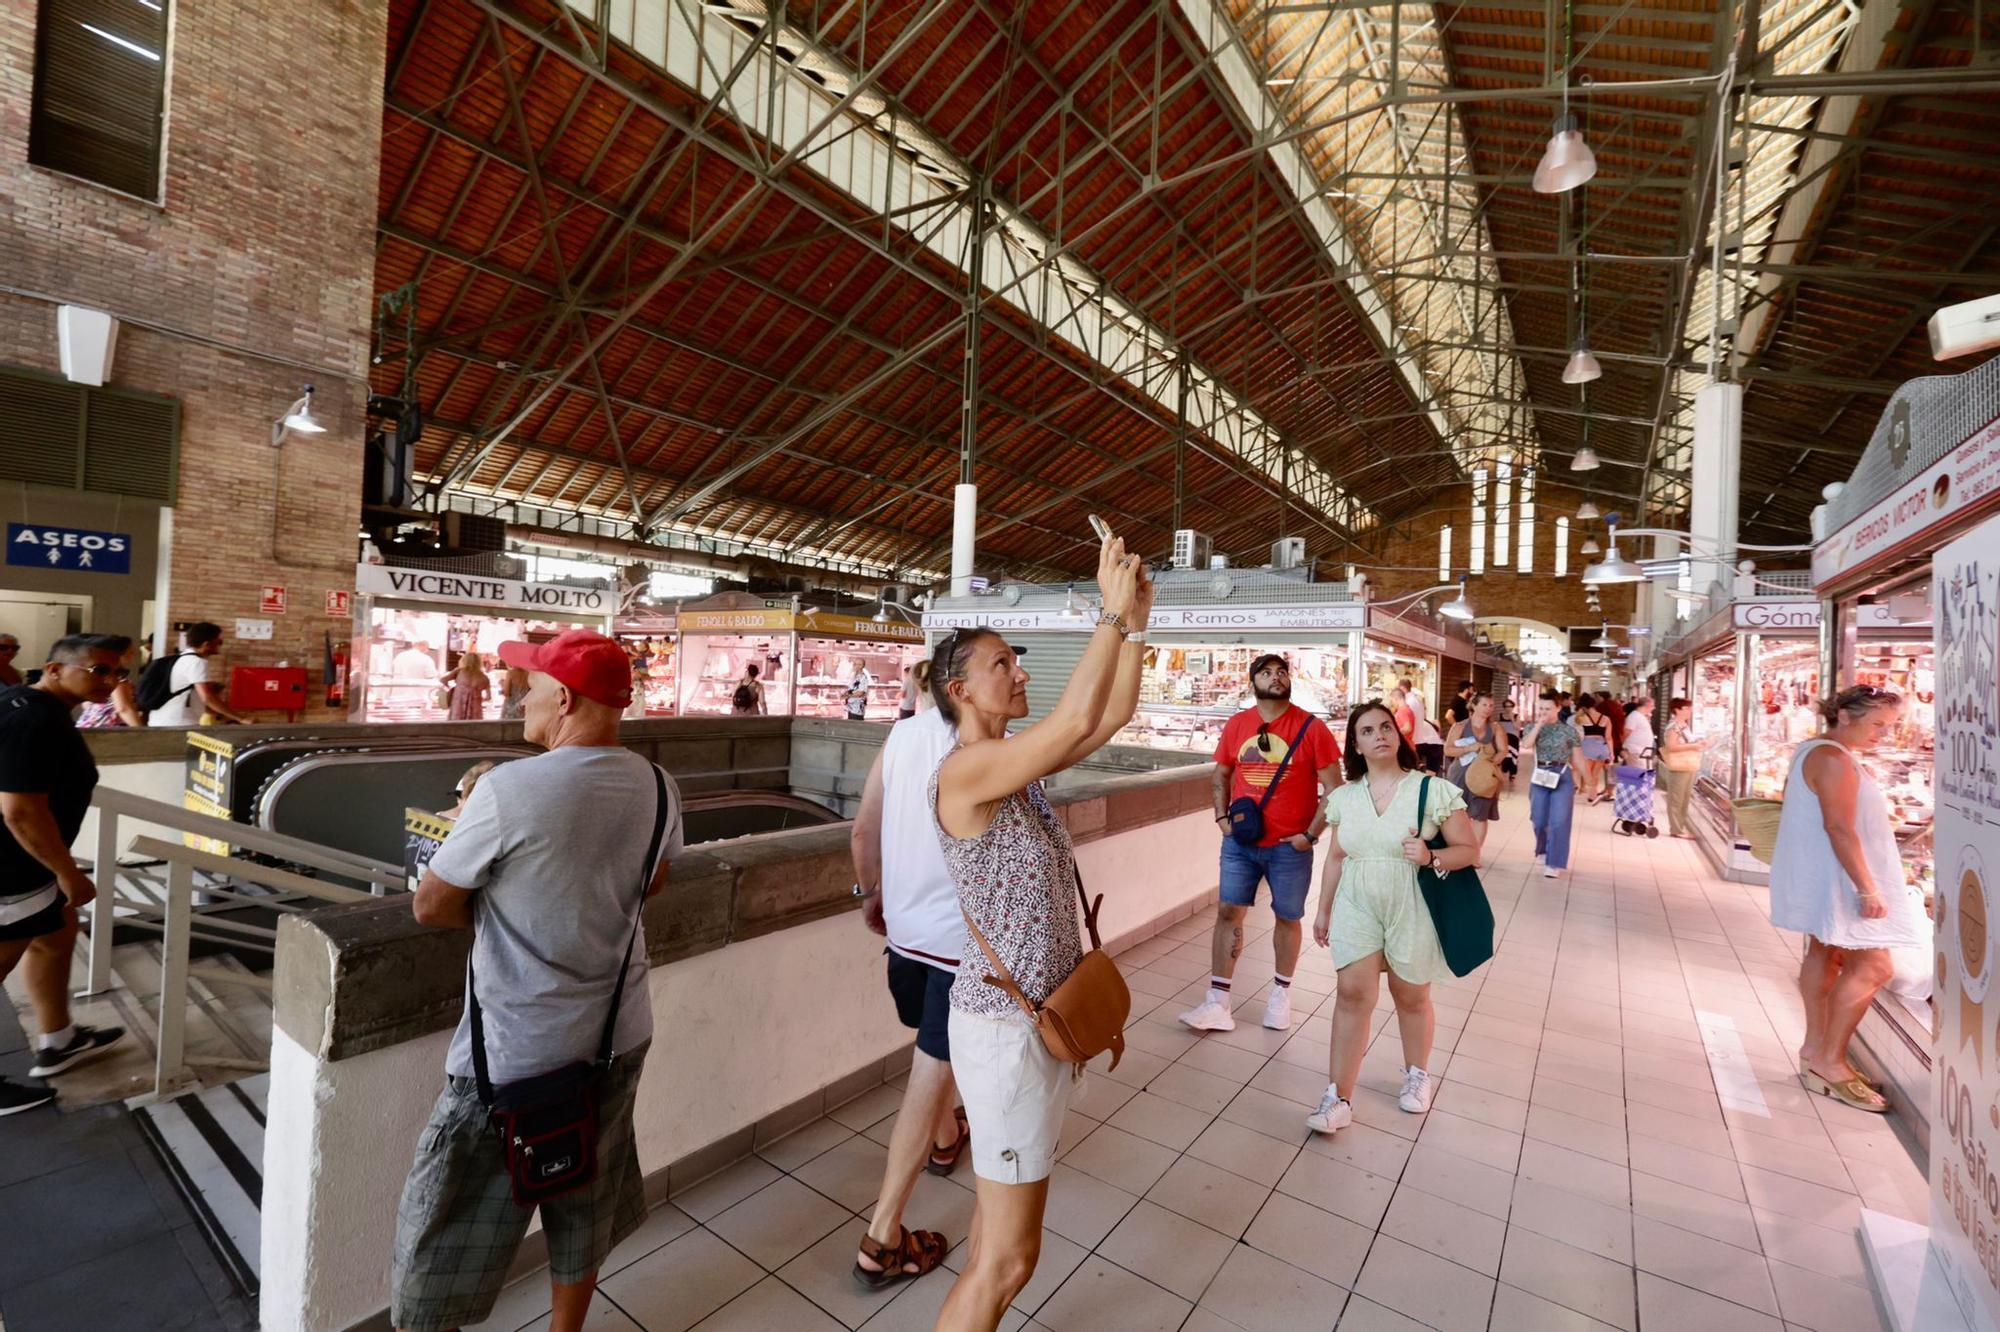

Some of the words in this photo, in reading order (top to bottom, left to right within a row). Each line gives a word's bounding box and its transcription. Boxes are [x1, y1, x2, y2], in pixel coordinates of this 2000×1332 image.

[1893, 487, 1927, 529] VICTOR
[14, 529, 125, 552] ASEOS
[387, 571, 505, 601] VICENTE
[520, 586, 601, 610] MOLTÓ
[696, 615, 726, 627] FENOLL
[727, 616, 734, 627] &
[1147, 614, 1171, 627] ge
[1182, 611, 1258, 624] Ramos
[1264, 608, 1327, 617] JAMONES
[1279, 618, 1353, 627] EMBUTIDOS
[1745, 605, 1821, 626] Góme
[1874, 607, 1889, 620] Q
[855, 620, 890, 635] FENOLL
[891, 625, 898, 636] &
[1951, 730, 1978, 776] 100
[1938, 1055, 1973, 1157] 100
[1967, 1139, 2000, 1219] año
[1972, 1199, 2000, 1292] lad
